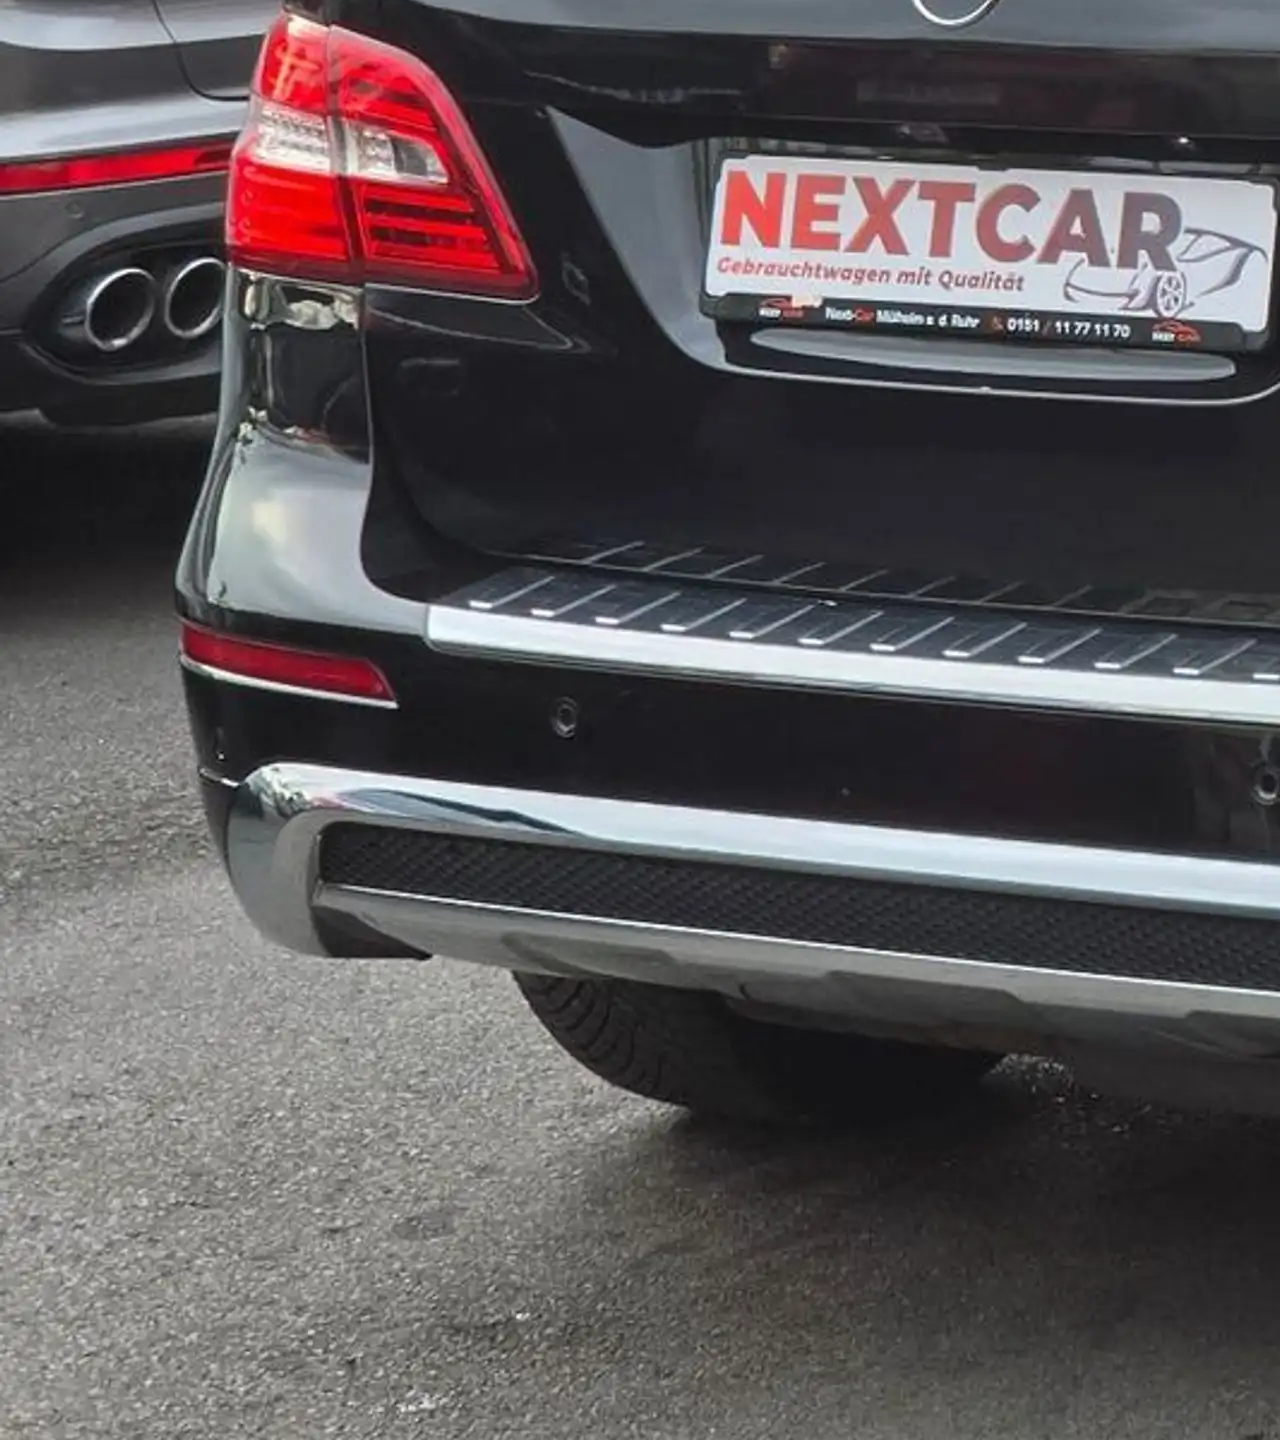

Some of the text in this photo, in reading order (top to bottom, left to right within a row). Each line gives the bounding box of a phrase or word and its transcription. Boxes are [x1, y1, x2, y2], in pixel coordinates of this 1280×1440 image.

[720, 169, 1184, 272] NEXTCAR
[717, 256, 1026, 292] Gebrauchtwagen mit Qualität
